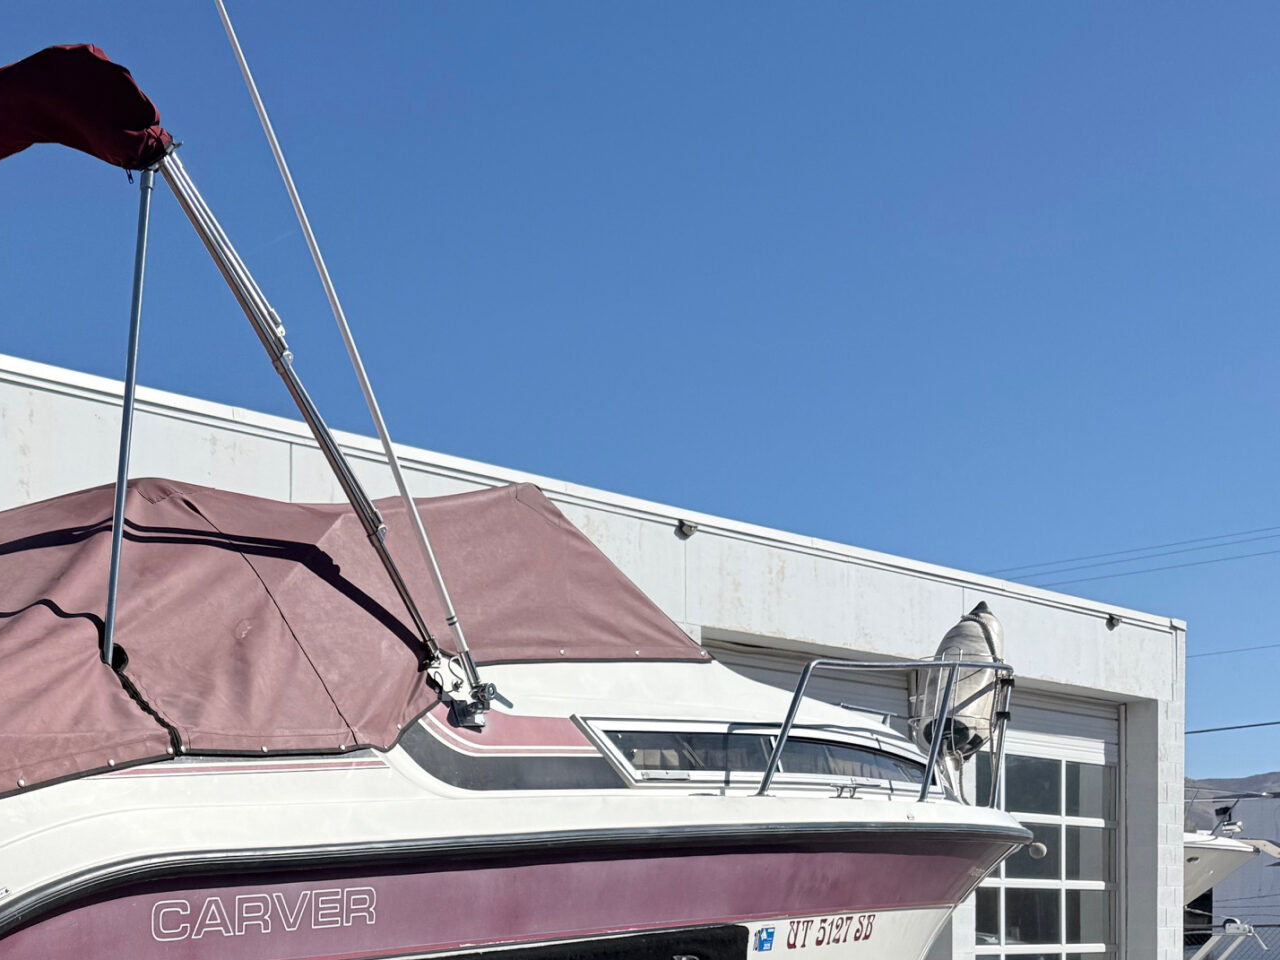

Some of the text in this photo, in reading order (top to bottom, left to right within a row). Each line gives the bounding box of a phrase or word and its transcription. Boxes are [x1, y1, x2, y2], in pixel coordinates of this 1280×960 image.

[151, 886, 376, 942] CARVER
[787, 919, 814, 949] UT
[815, 916, 854, 947] 5127
[853, 914, 876, 942] SB
